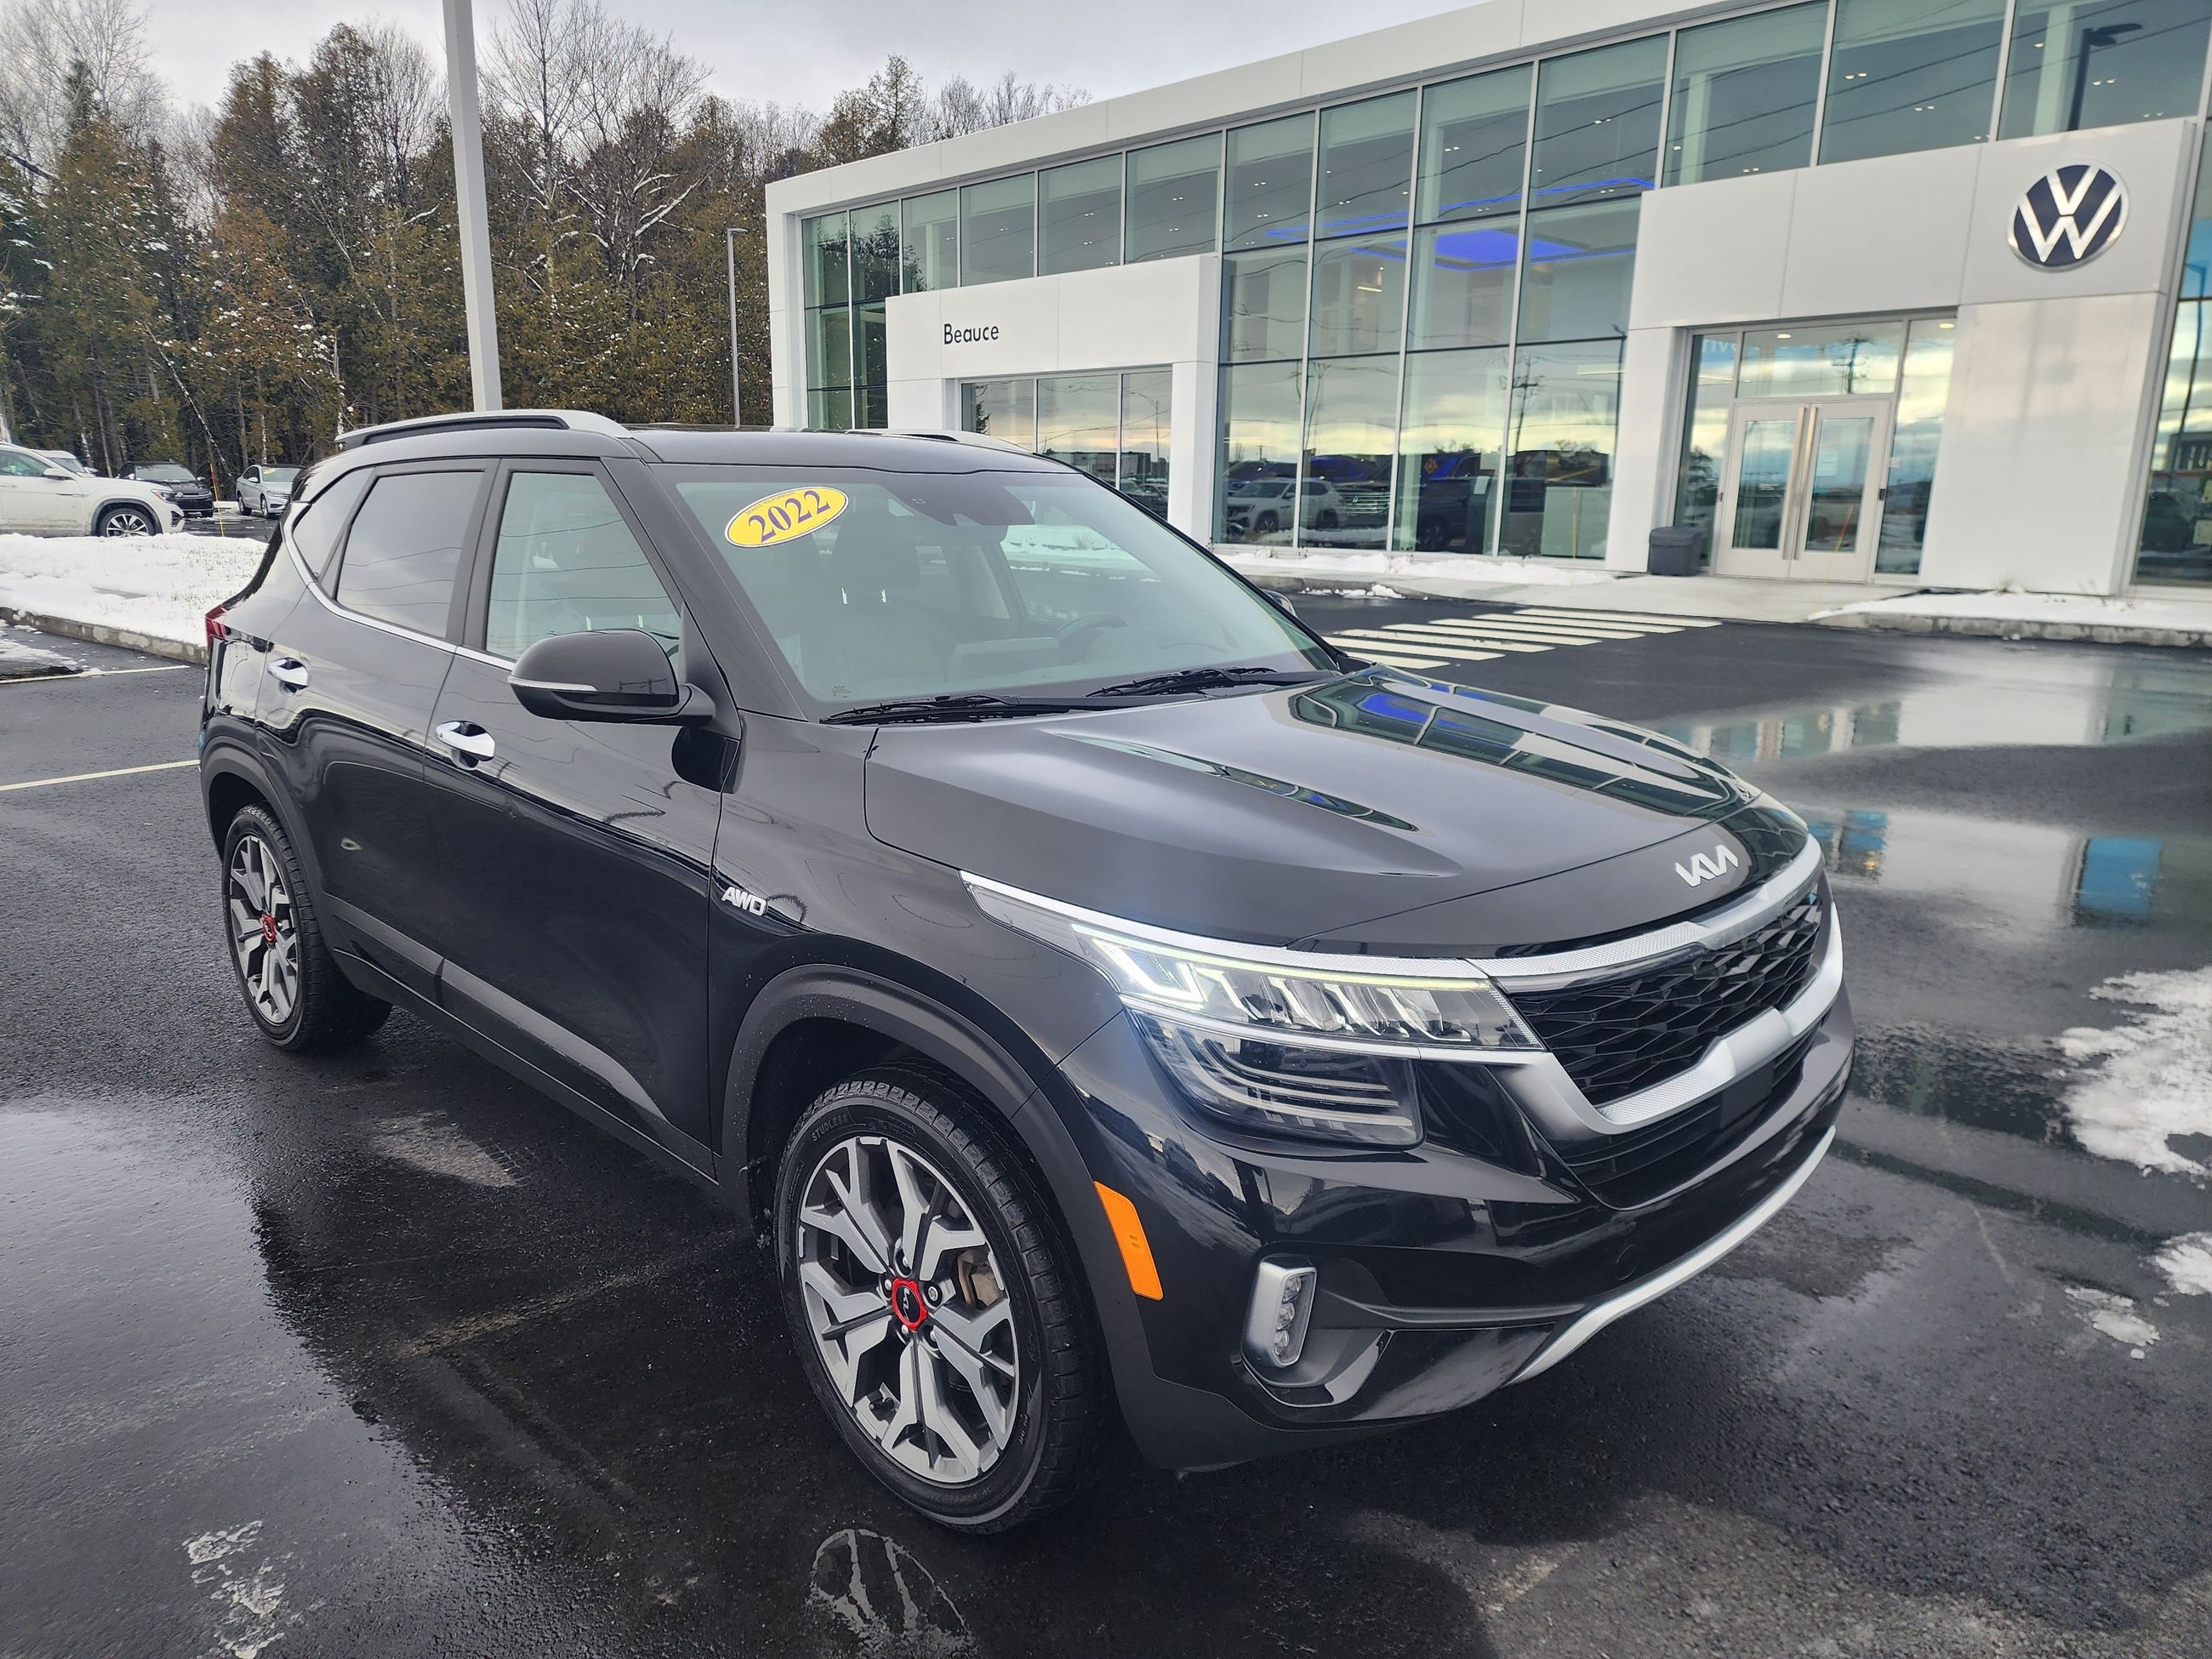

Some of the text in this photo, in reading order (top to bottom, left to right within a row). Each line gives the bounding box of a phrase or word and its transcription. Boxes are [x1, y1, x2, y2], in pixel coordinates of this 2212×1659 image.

[2016, 163, 2124, 265] VW
[944, 323, 1000, 345] Beauce
[748, 490, 831, 544] 2022
[1674, 844, 1739, 888] KIA
[721, 887, 767, 916] AWD
[811, 1115, 848, 1142] STUDLESS
